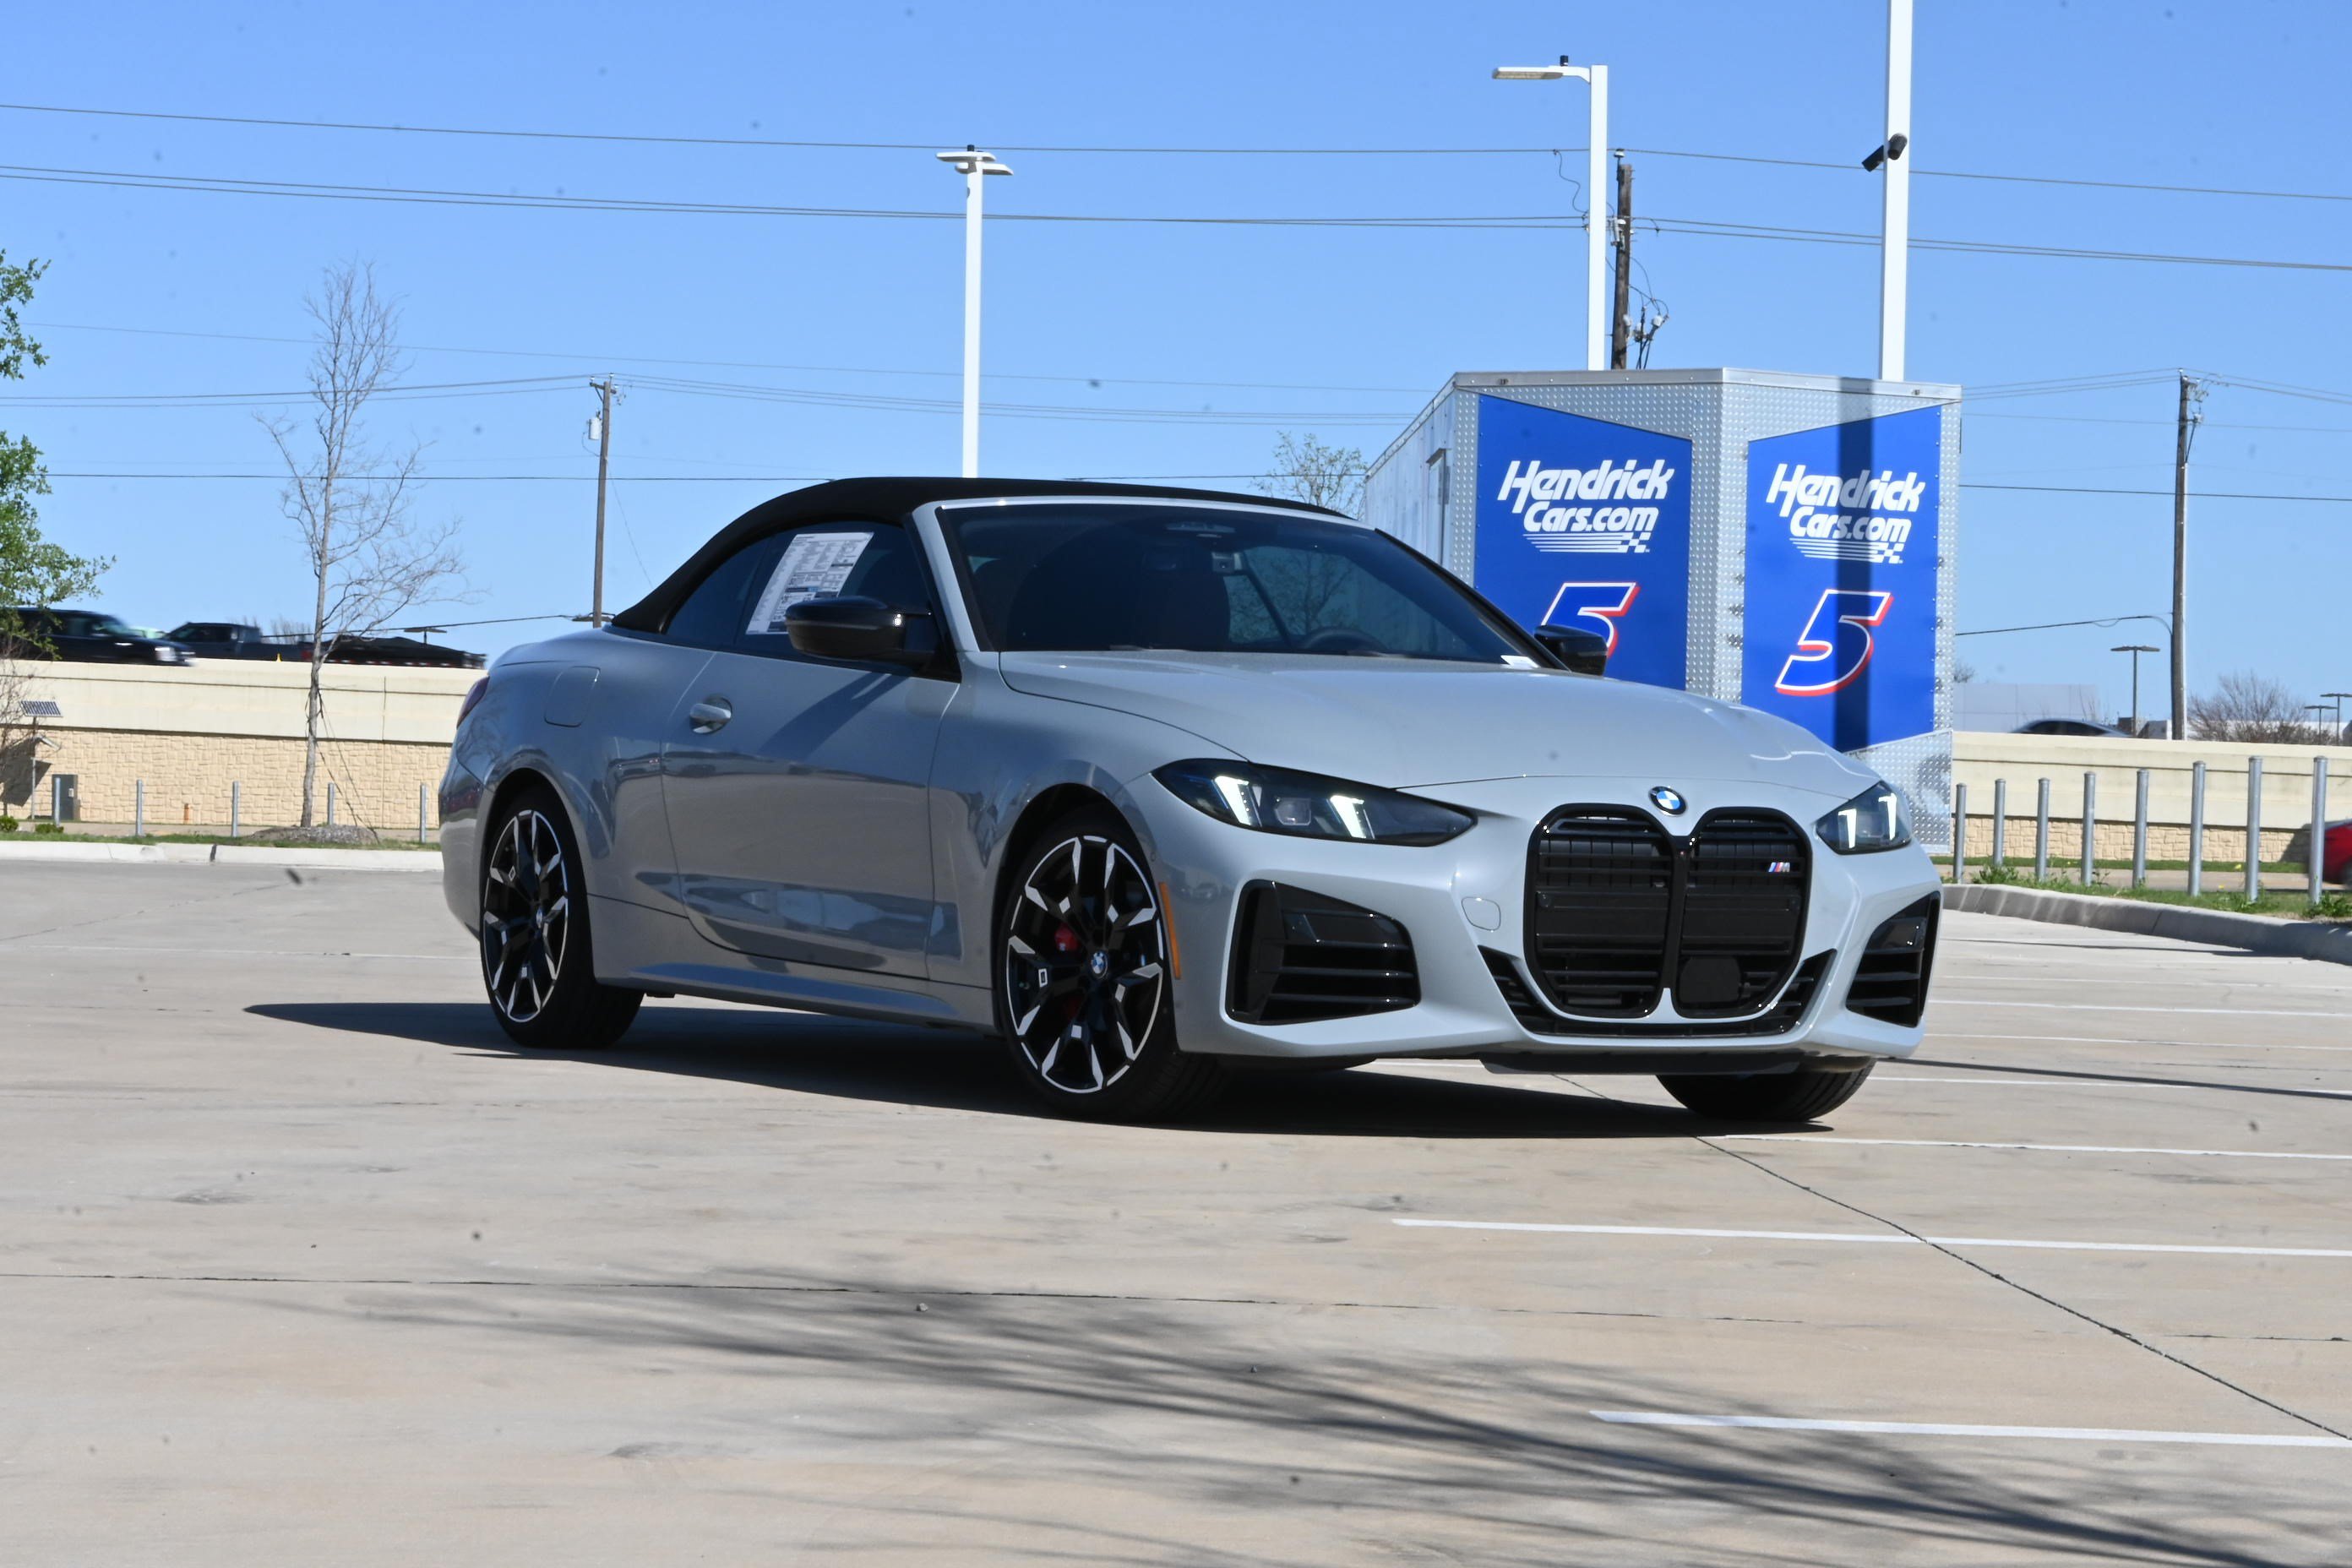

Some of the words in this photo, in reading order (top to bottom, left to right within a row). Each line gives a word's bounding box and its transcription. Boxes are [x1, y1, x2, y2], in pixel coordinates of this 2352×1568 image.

[1497, 459, 1675, 514] Hendrick
[1766, 463, 1926, 518] Hendrick
[1523, 501, 1659, 532] Cars.com
[1790, 506, 1912, 542] Cars.com
[1775, 588, 1894, 697] 5
